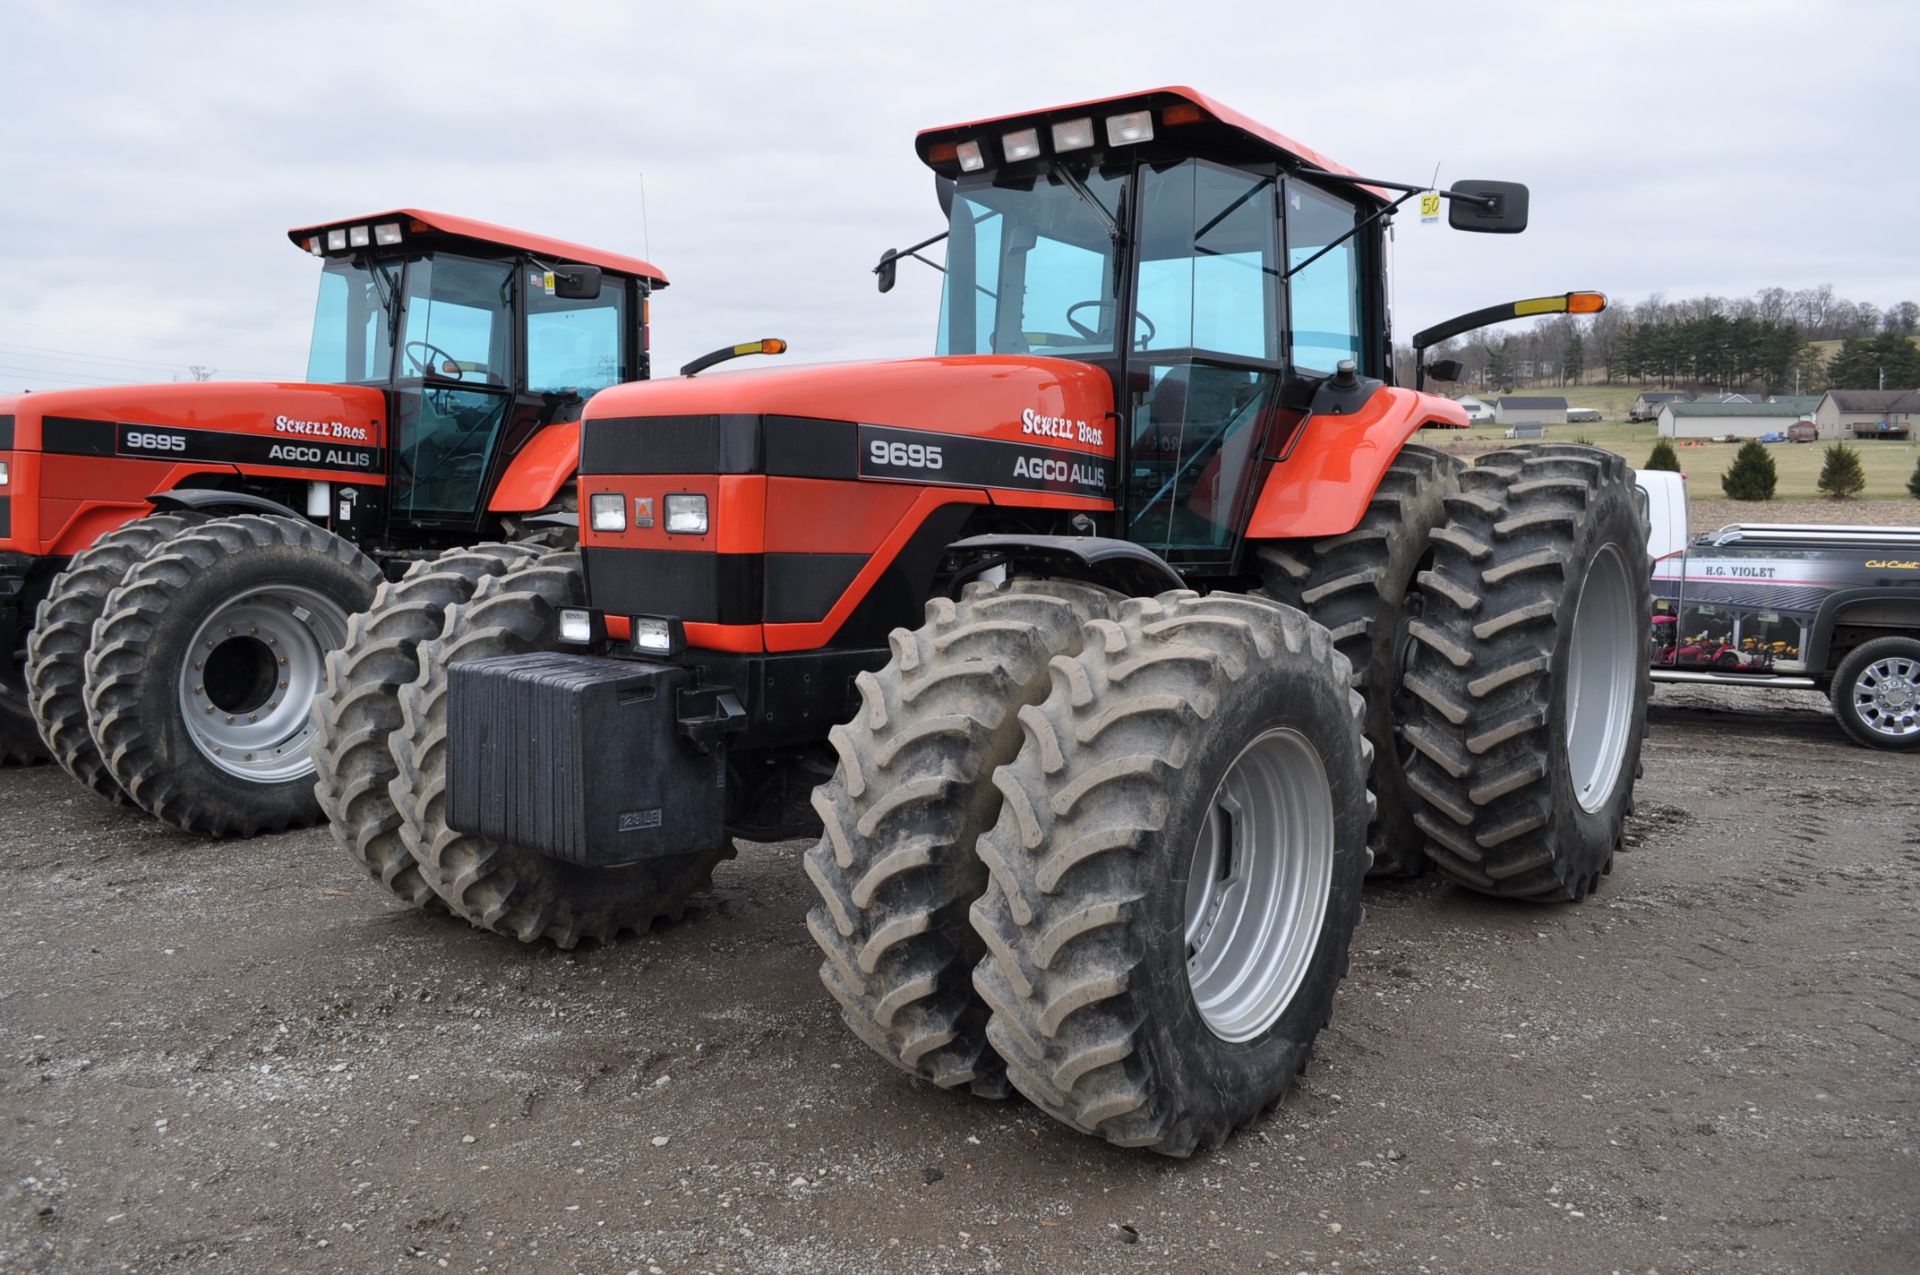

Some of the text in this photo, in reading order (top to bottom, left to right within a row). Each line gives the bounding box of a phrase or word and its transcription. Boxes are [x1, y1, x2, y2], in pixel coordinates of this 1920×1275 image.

[1421, 196, 1440, 215] 50
[275, 415, 368, 440] SCHELL BROS.
[1021, 408, 1104, 446] SCHELL BROS.
[126, 431, 186, 451] 9695
[269, 444, 370, 467] AGCO ALLIS
[870, 440, 943, 470] 9695
[1012, 456, 1105, 487] AGCO ALLIS
[1705, 566, 1776, 578] H.G. VIOLET
[1864, 559, 1920, 569] Cub Cadet
